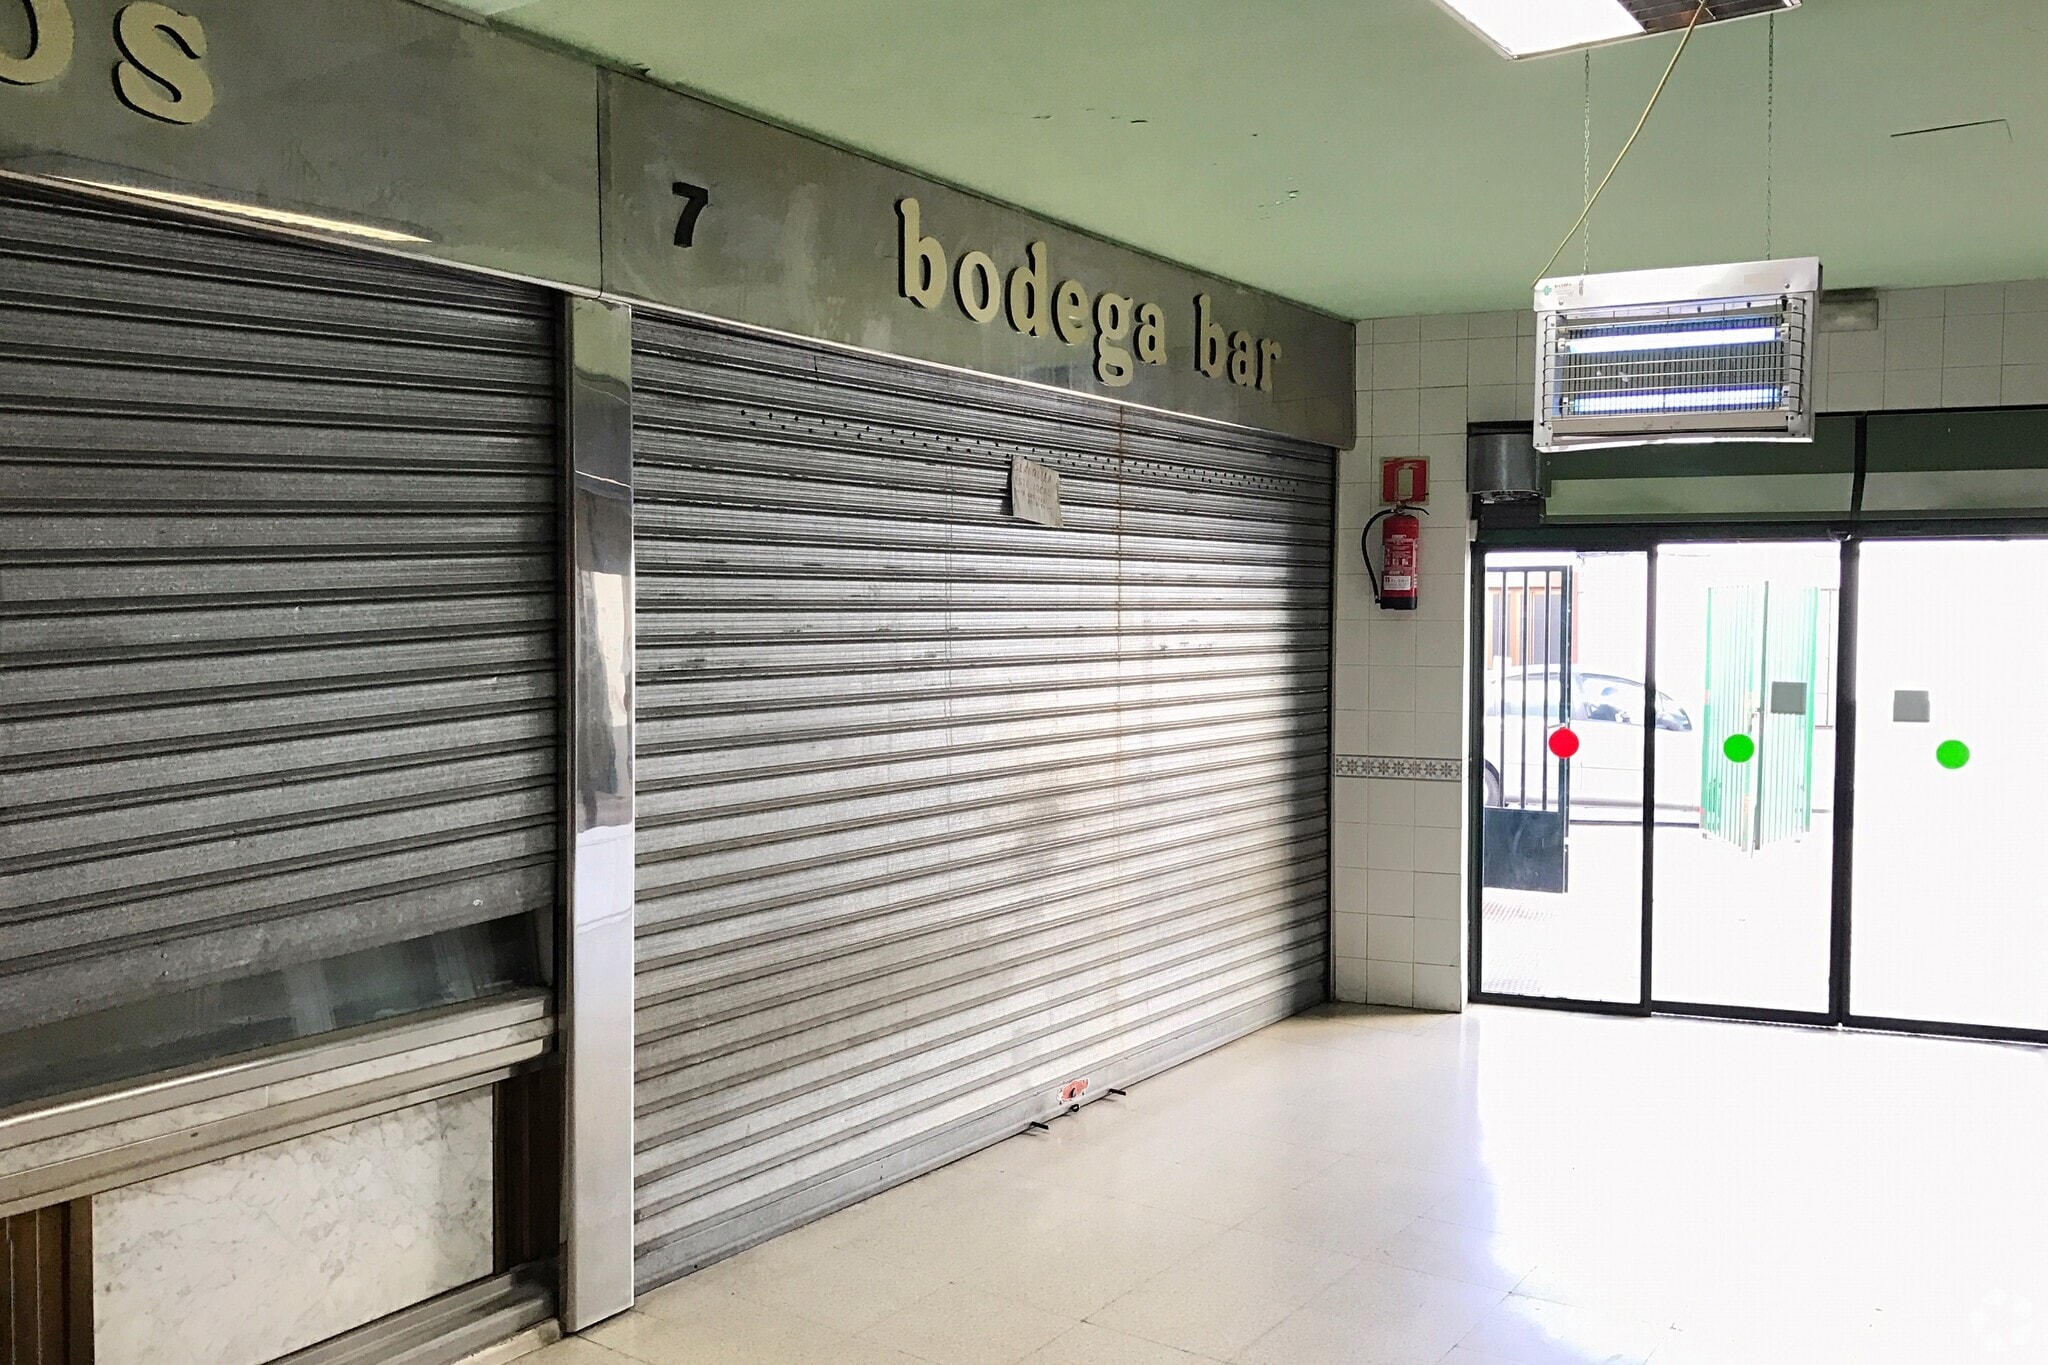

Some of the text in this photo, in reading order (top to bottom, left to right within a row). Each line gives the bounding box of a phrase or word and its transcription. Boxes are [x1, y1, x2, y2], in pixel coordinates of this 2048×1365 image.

[672, 182, 708, 248] 7
[895, 198, 1282, 393] bodega bar
